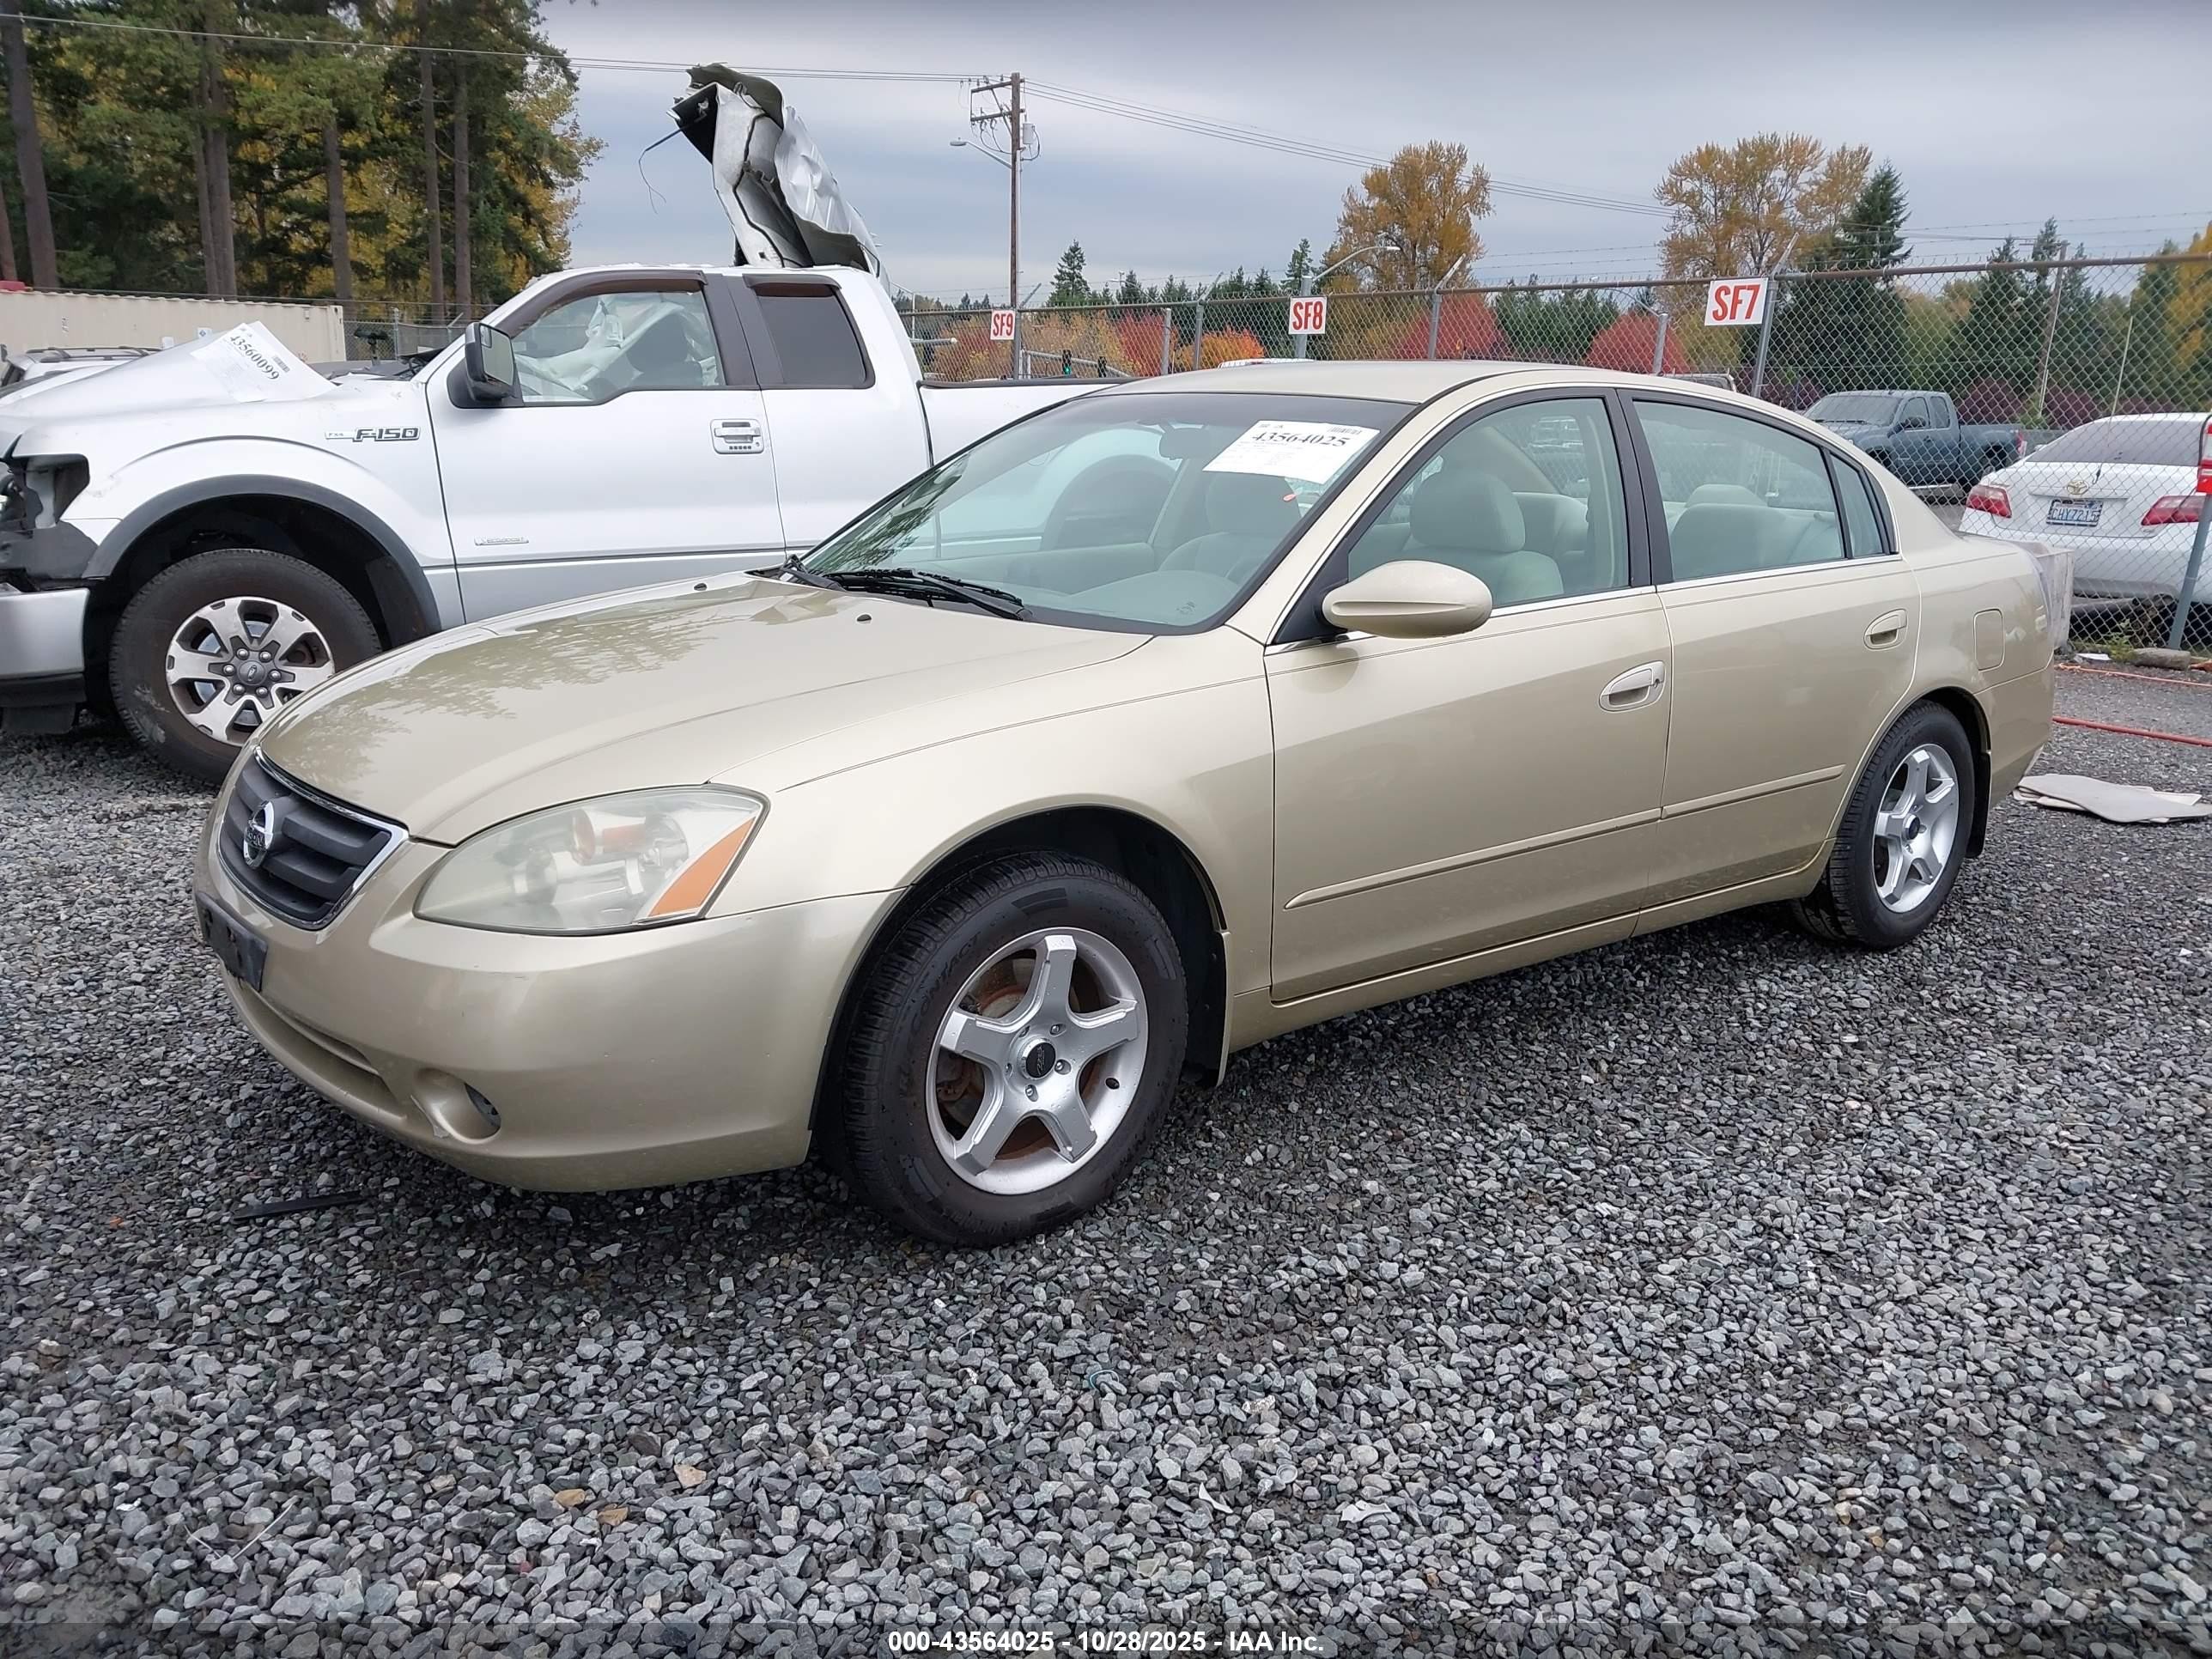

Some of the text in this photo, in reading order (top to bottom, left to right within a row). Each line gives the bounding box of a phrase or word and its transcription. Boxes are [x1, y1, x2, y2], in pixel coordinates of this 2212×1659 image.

[1291, 301, 1323, 331] SF8
[1712, 284, 1761, 321] SF7
[993, 313, 1013, 337] SF9
[230, 336, 280, 380] 43560099
[356, 428, 418, 439] F-150
[1251, 431, 1352, 447] 43564025
